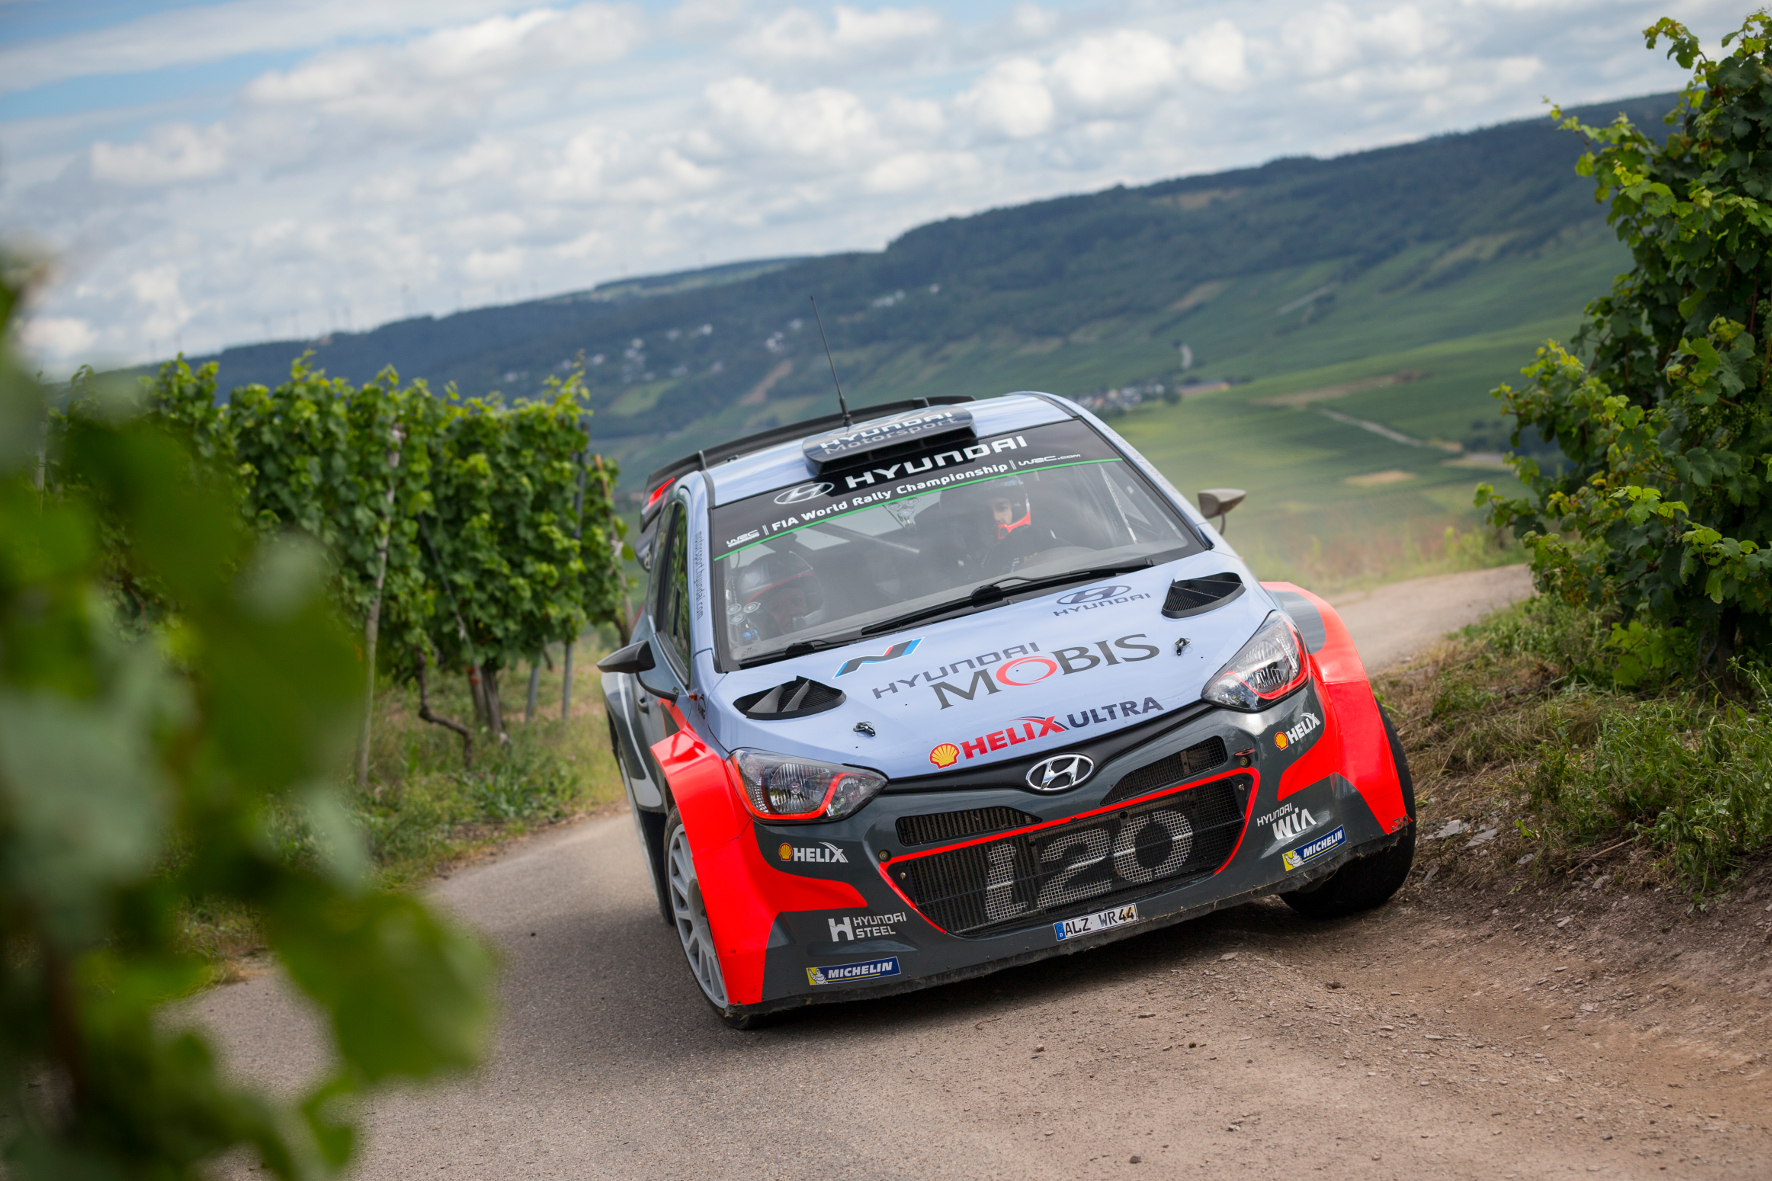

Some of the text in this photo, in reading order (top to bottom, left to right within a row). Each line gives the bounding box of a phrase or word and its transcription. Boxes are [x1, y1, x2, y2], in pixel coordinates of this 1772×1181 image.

[820, 412, 953, 448] HYUNDAI
[824, 417, 958, 454] Motorsport
[845, 435, 1028, 489] HYUNDAI
[771, 516, 799, 531] FIA
[801, 501, 848, 521] World
[852, 490, 891, 507] Rally
[896, 463, 1008, 495] Championship
[1053, 592, 1152, 617] HYUNDAI
[872, 642, 1041, 699] HYUNDAI
[928, 633, 1160, 710] MOBIS
[959, 696, 1165, 760] HELIX ULTRA
[1285, 712, 1321, 745] HELIX
[1256, 802, 1293, 827] HYUNDAI
[793, 842, 849, 863] HELIX
[1303, 829, 1343, 858] MICHELIN
[853, 912, 907, 927] HYUNDAI
[856, 926, 896, 939] STEEL
[1065, 917, 1091, 936] ALZ
[827, 961, 893, 979] MICHELIN
